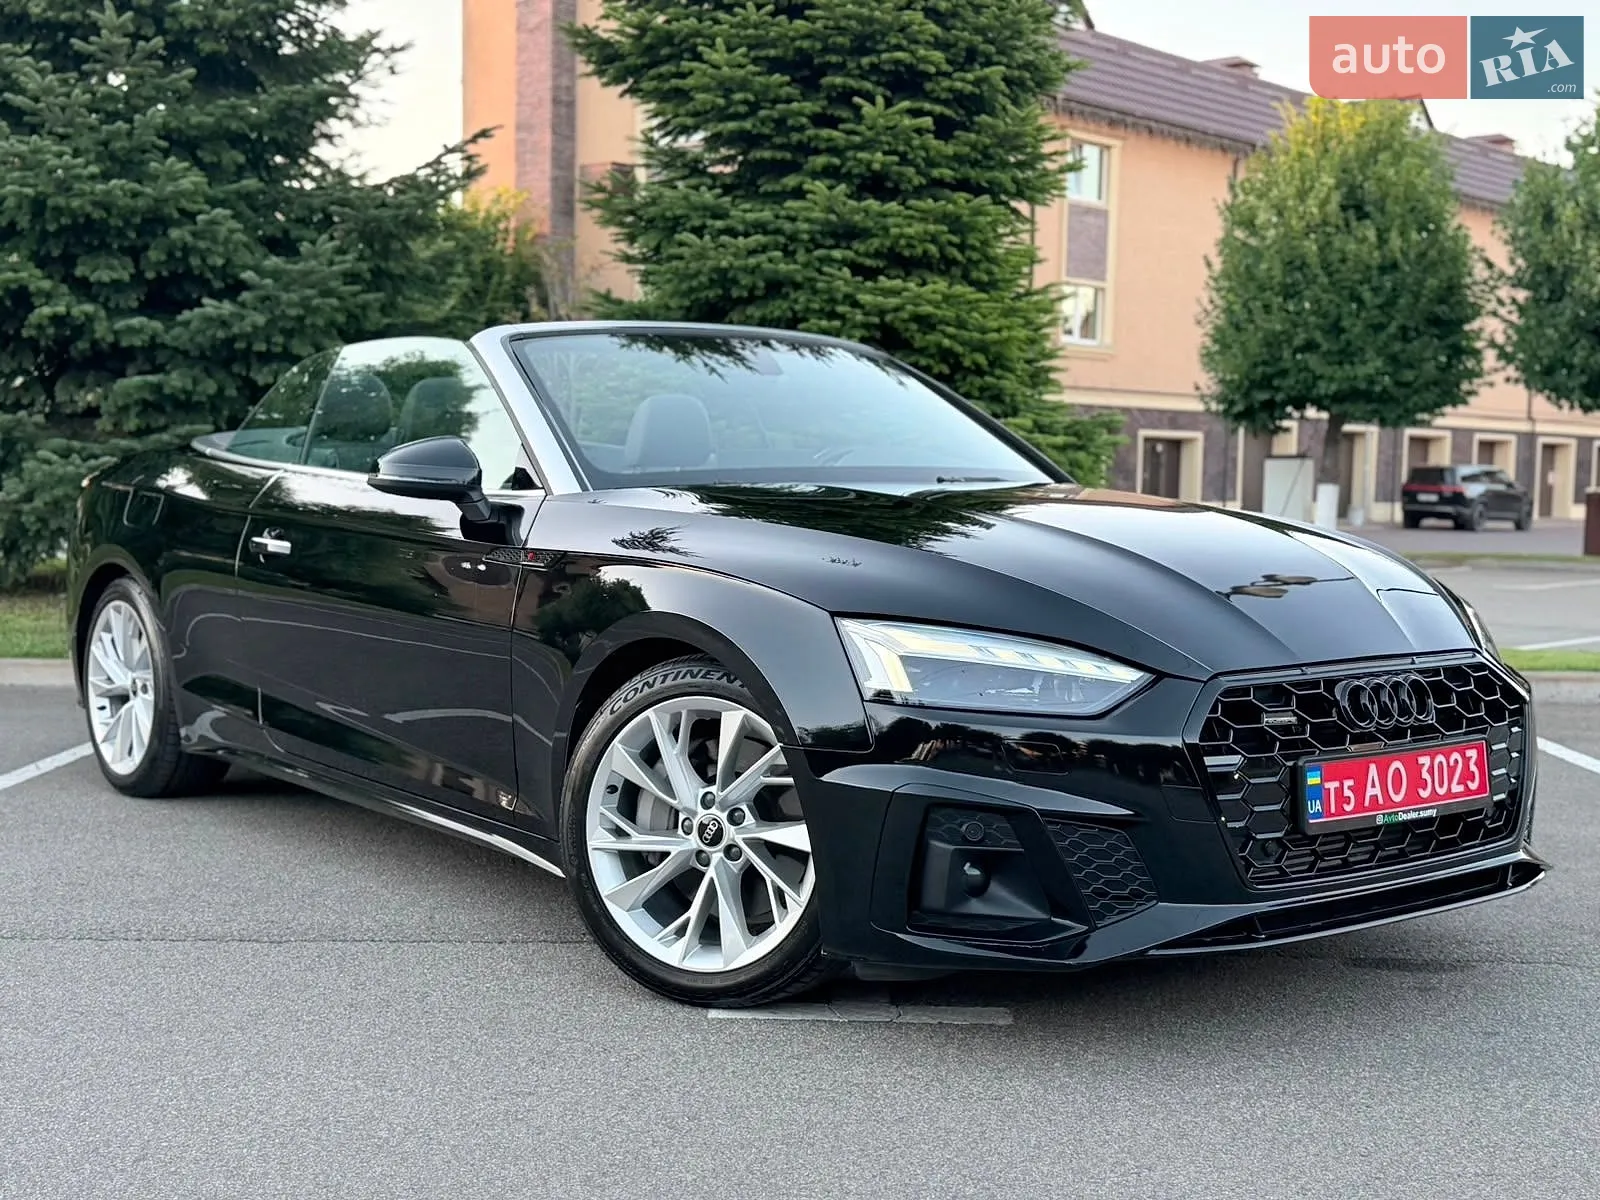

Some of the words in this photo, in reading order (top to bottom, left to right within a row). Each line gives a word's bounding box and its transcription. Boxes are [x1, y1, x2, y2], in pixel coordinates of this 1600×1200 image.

[608, 668, 745, 715] CONTINEN
[1324, 779, 1356, 814] T5
[1363, 760, 1408, 807] AO
[1416, 748, 1481, 799] 3023
[1307, 800, 1322, 814] UA
